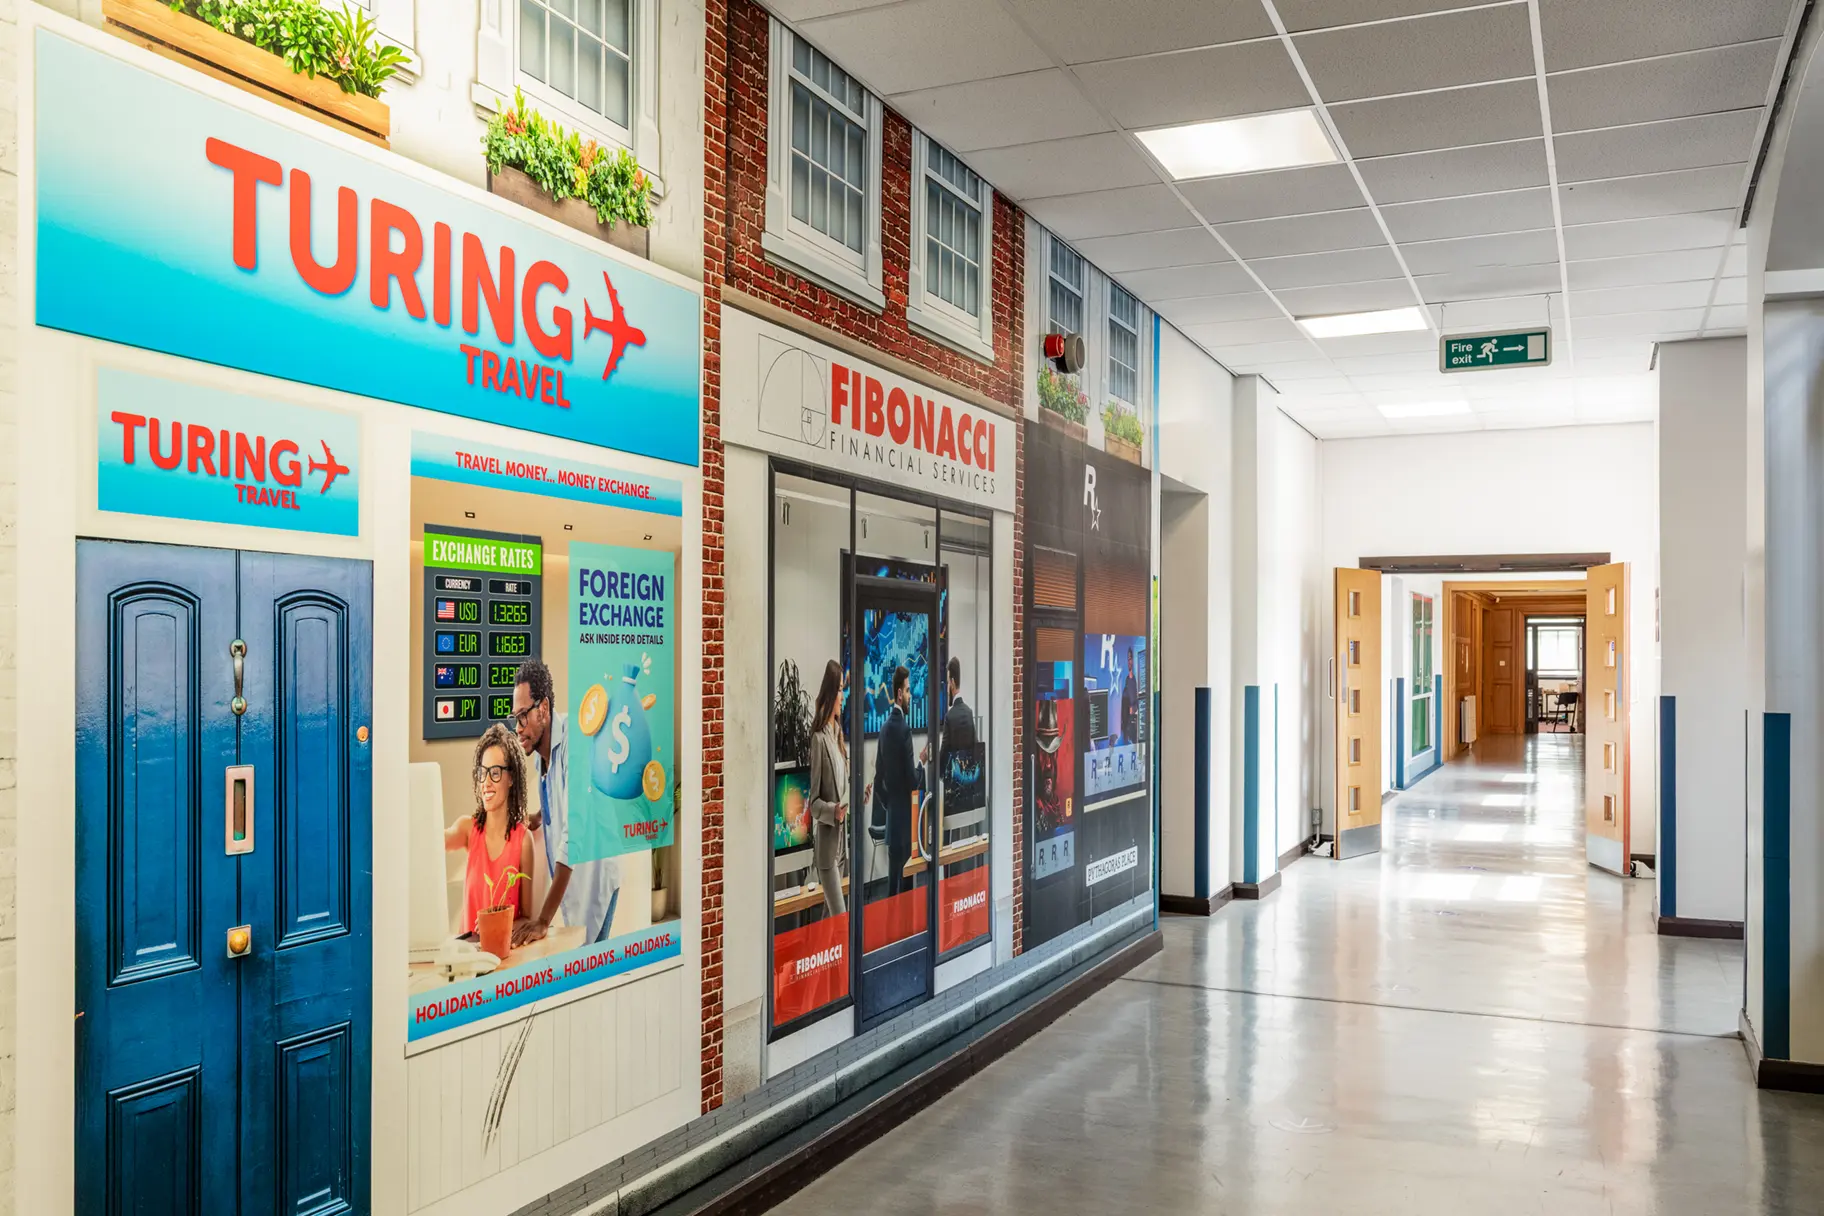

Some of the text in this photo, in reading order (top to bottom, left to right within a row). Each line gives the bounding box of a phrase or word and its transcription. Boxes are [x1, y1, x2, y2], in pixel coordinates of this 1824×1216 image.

[205, 136, 573, 362] TURING
[1451, 343, 1473, 353] Fire
[1452, 354, 1472, 365] exit
[460, 344, 571, 409] TRAVEL
[831, 362, 995, 473] FIBONACCI
[111, 411, 302, 488] TURING
[830, 431, 995, 495] FINANCIAL SERVICES
[455, 451, 657, 501] TRAVEL MONEY... MONEY EXCHANGE...
[234, 483, 300, 511] TRAVEL
[432, 540, 534, 570] EXCHANGE RATES
[445, 578, 517, 593] CURRENCY RATE
[579, 568, 664, 601] FOREIGN
[459, 602, 528, 623] USD 1.3265
[579, 602, 664, 628] EXCHANGE
[459, 634, 525, 654] EUR 1.1663
[579, 633, 664, 645] ASK INSIDE FOR DETAILS
[459, 667, 520, 685] AUD 2.03
[460, 698, 510, 718] JPY 185
[623, 819, 659, 839] TURING
[1088, 850, 1136, 881] PYTHAGORAS PLACE
[954, 890, 986, 913] FIBONACCI
[796, 943, 843, 975] FIBONACCI
[416, 933, 677, 1024] HOLIDAYS... HOLIDAYS... HOLIDAYS... HOLIDAYS...
